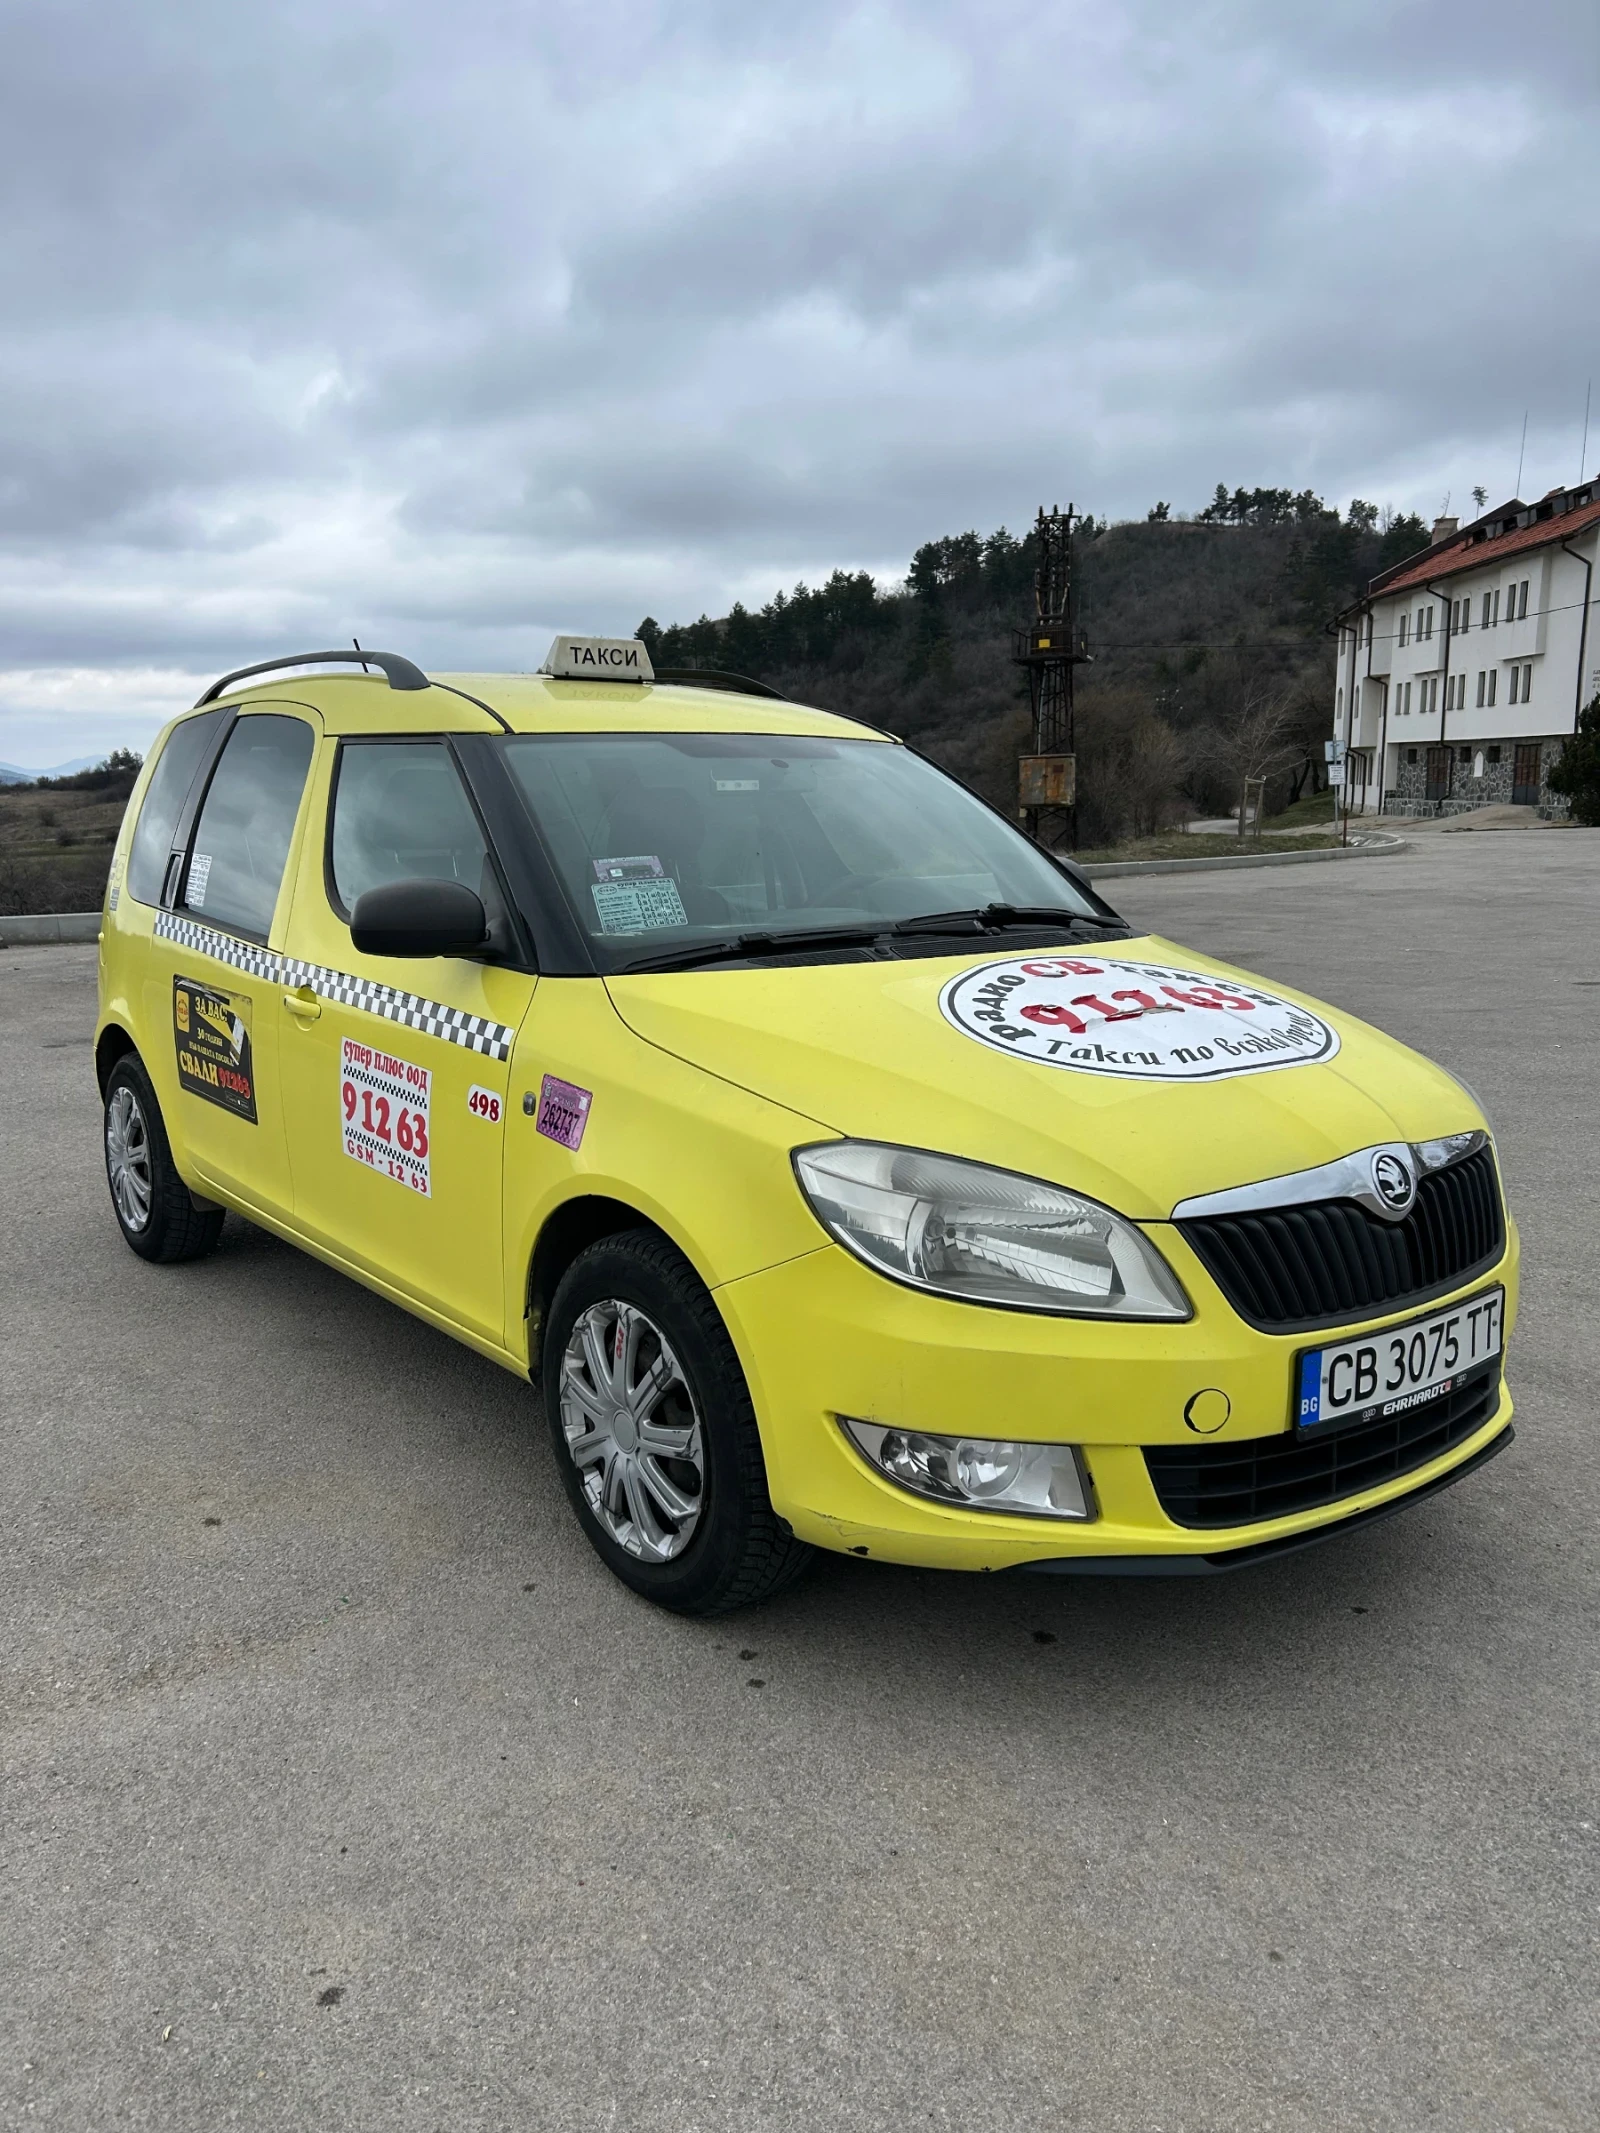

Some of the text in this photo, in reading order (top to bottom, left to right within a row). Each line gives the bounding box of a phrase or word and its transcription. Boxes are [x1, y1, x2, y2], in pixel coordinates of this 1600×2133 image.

[569, 646, 638, 667] ТАКСИ
[180, 1049, 219, 1087] СВАЛИ
[343, 1040, 428, 1095] супер плюс оод
[1046, 1039, 1166, 1066] Такси
[1170, 1044, 1214, 1064] по
[469, 1091, 500, 1122] 498
[541, 1100, 580, 1138] 262737
[347, 1139, 375, 1166] GSM
[1328, 1298, 1498, 1408] CB 3075 TT
[1301, 1396, 1318, 1416] BG
